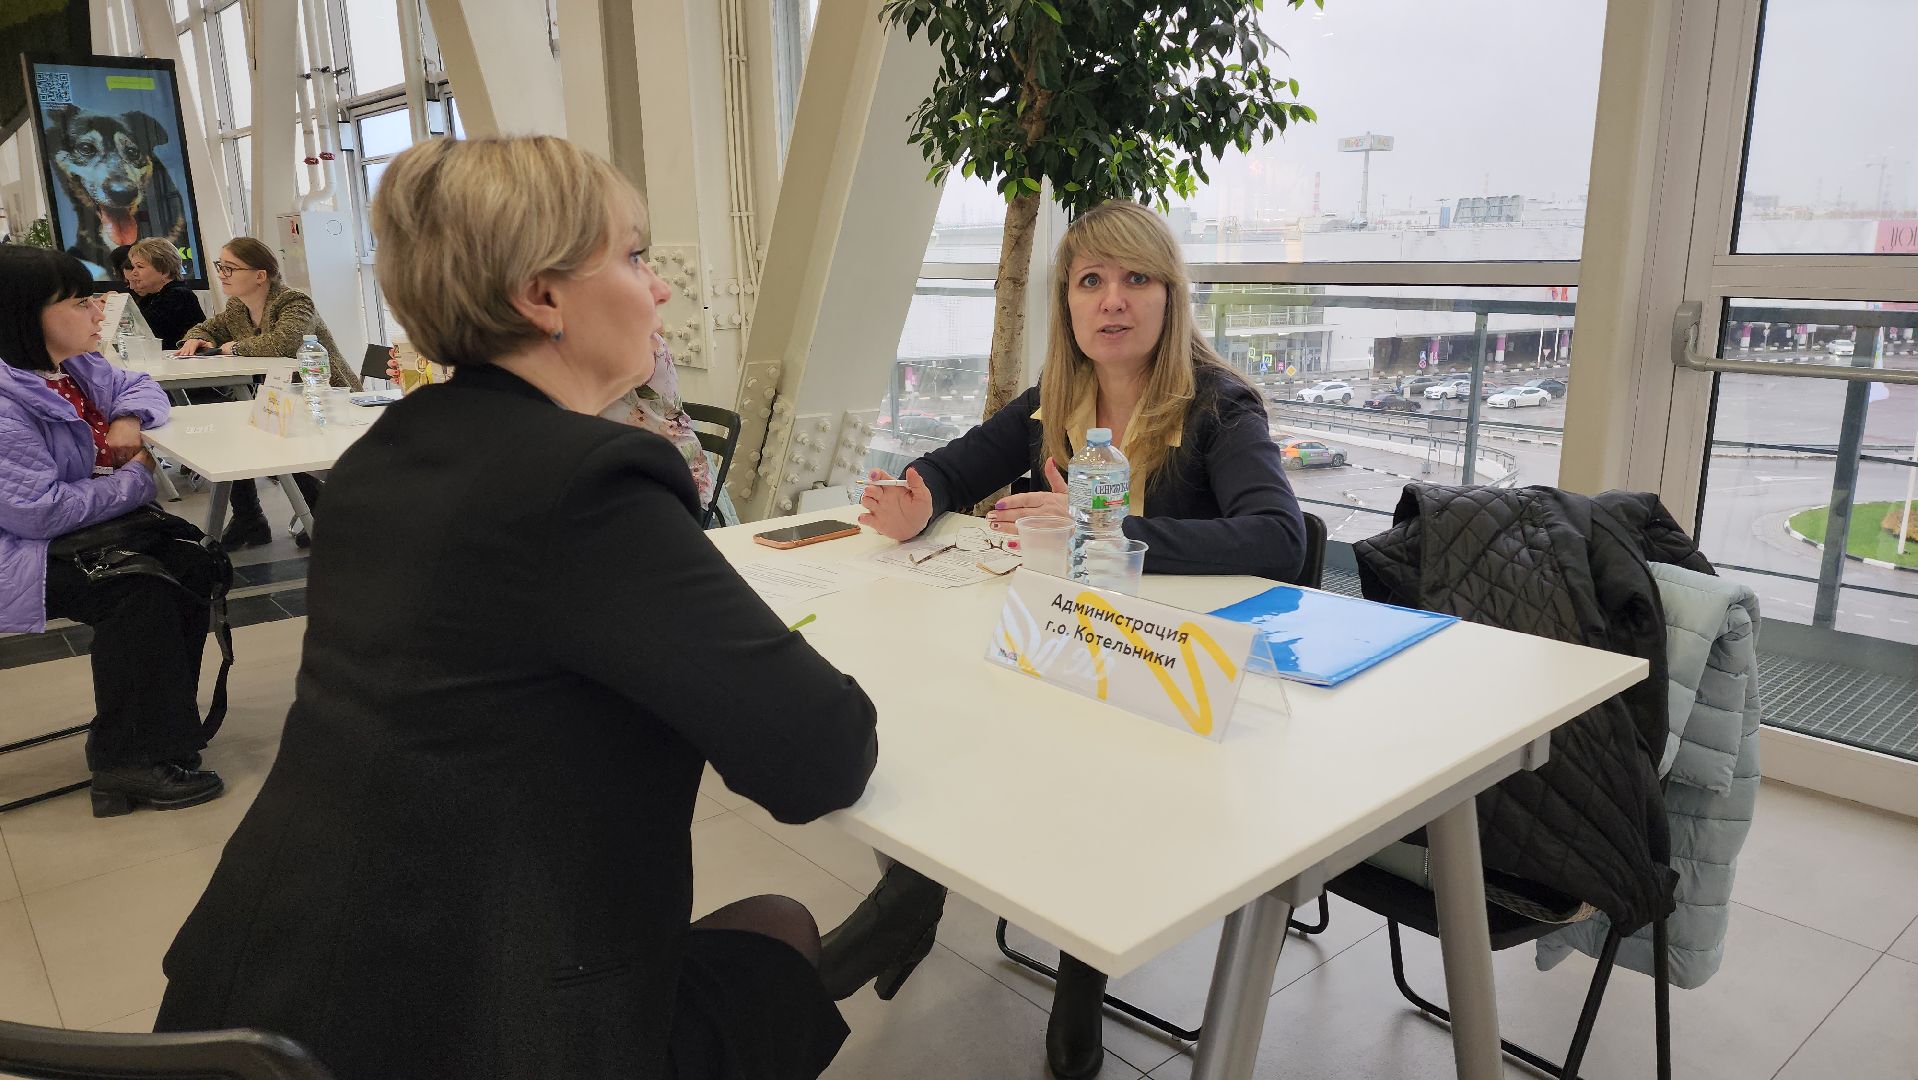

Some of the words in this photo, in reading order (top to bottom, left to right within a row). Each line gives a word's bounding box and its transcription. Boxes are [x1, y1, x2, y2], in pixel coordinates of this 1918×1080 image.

[1051, 593, 1189, 645] Администрация
[1045, 620, 1069, 637] г.о.
[1073, 624, 1177, 669] Котельники
